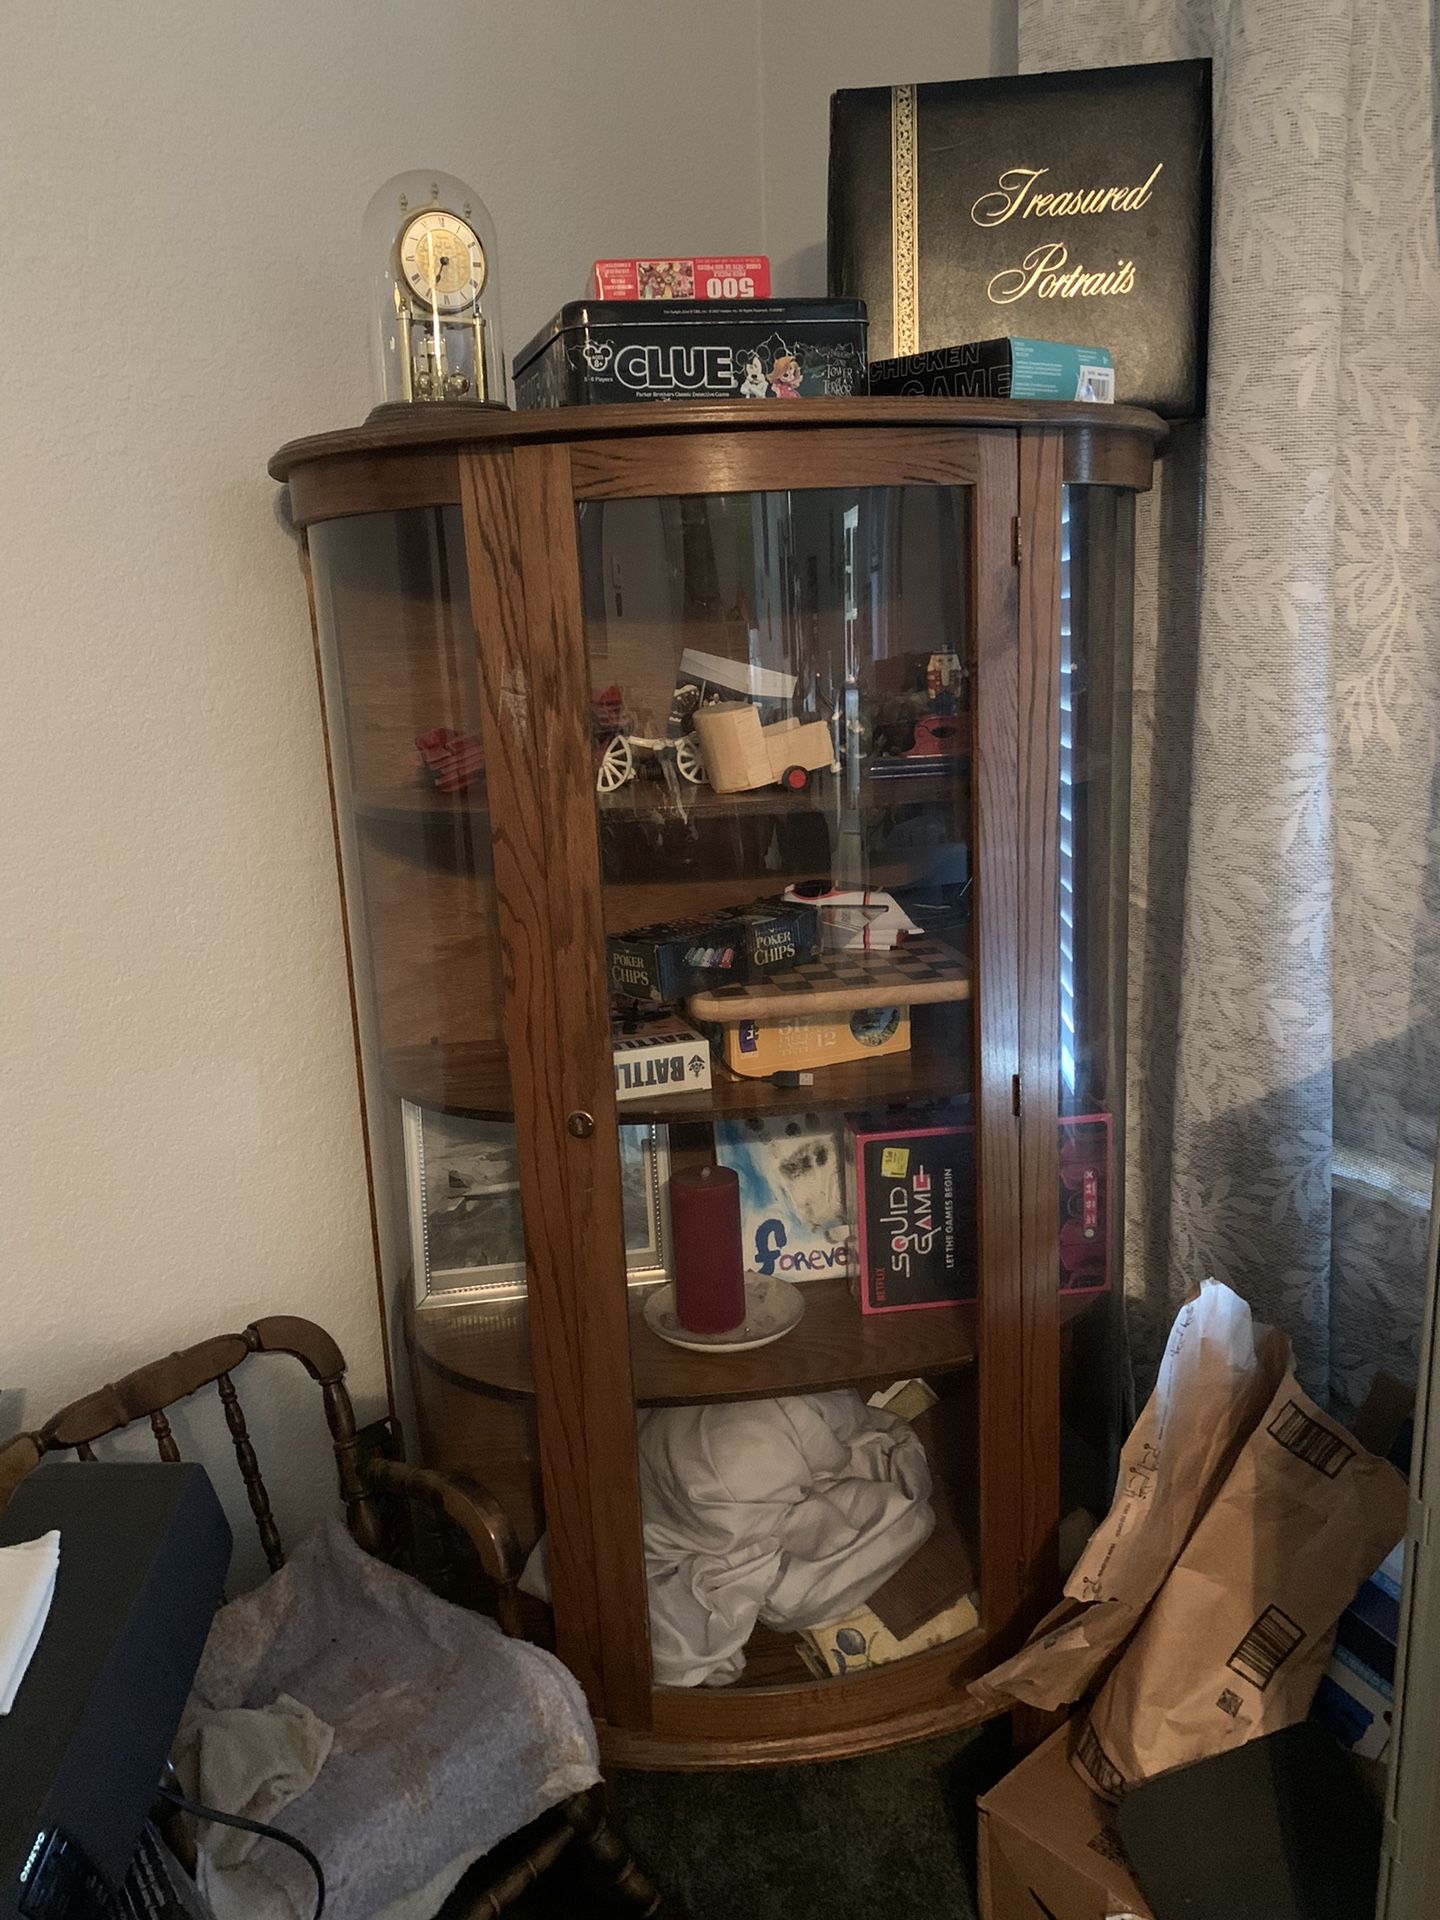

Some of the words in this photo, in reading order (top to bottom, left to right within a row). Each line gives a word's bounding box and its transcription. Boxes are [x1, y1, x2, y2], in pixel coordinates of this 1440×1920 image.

[971, 162, 1163, 227] Treasured
[706, 277, 755, 299] 500
[987, 242, 1136, 304] Portraits
[614, 345, 735, 389] CLUE
[869, 341, 980, 382] CHICKEN
[754, 943, 796, 966] CHIPS
[757, 931, 791, 948] POKER
[612, 965, 649, 986] CHIPS
[613, 952, 645, 968] POKER
[944, 1168, 953, 1199] BEGIN
[913, 1165, 941, 1254] GAME
[945, 1200, 953, 1234] GAMES
[879, 1186, 910, 1278] SQUID
[945, 1235, 953, 1252] THE
[946, 1253, 954, 1269] LET
[20, 1831, 45, 1882] ONKYO
